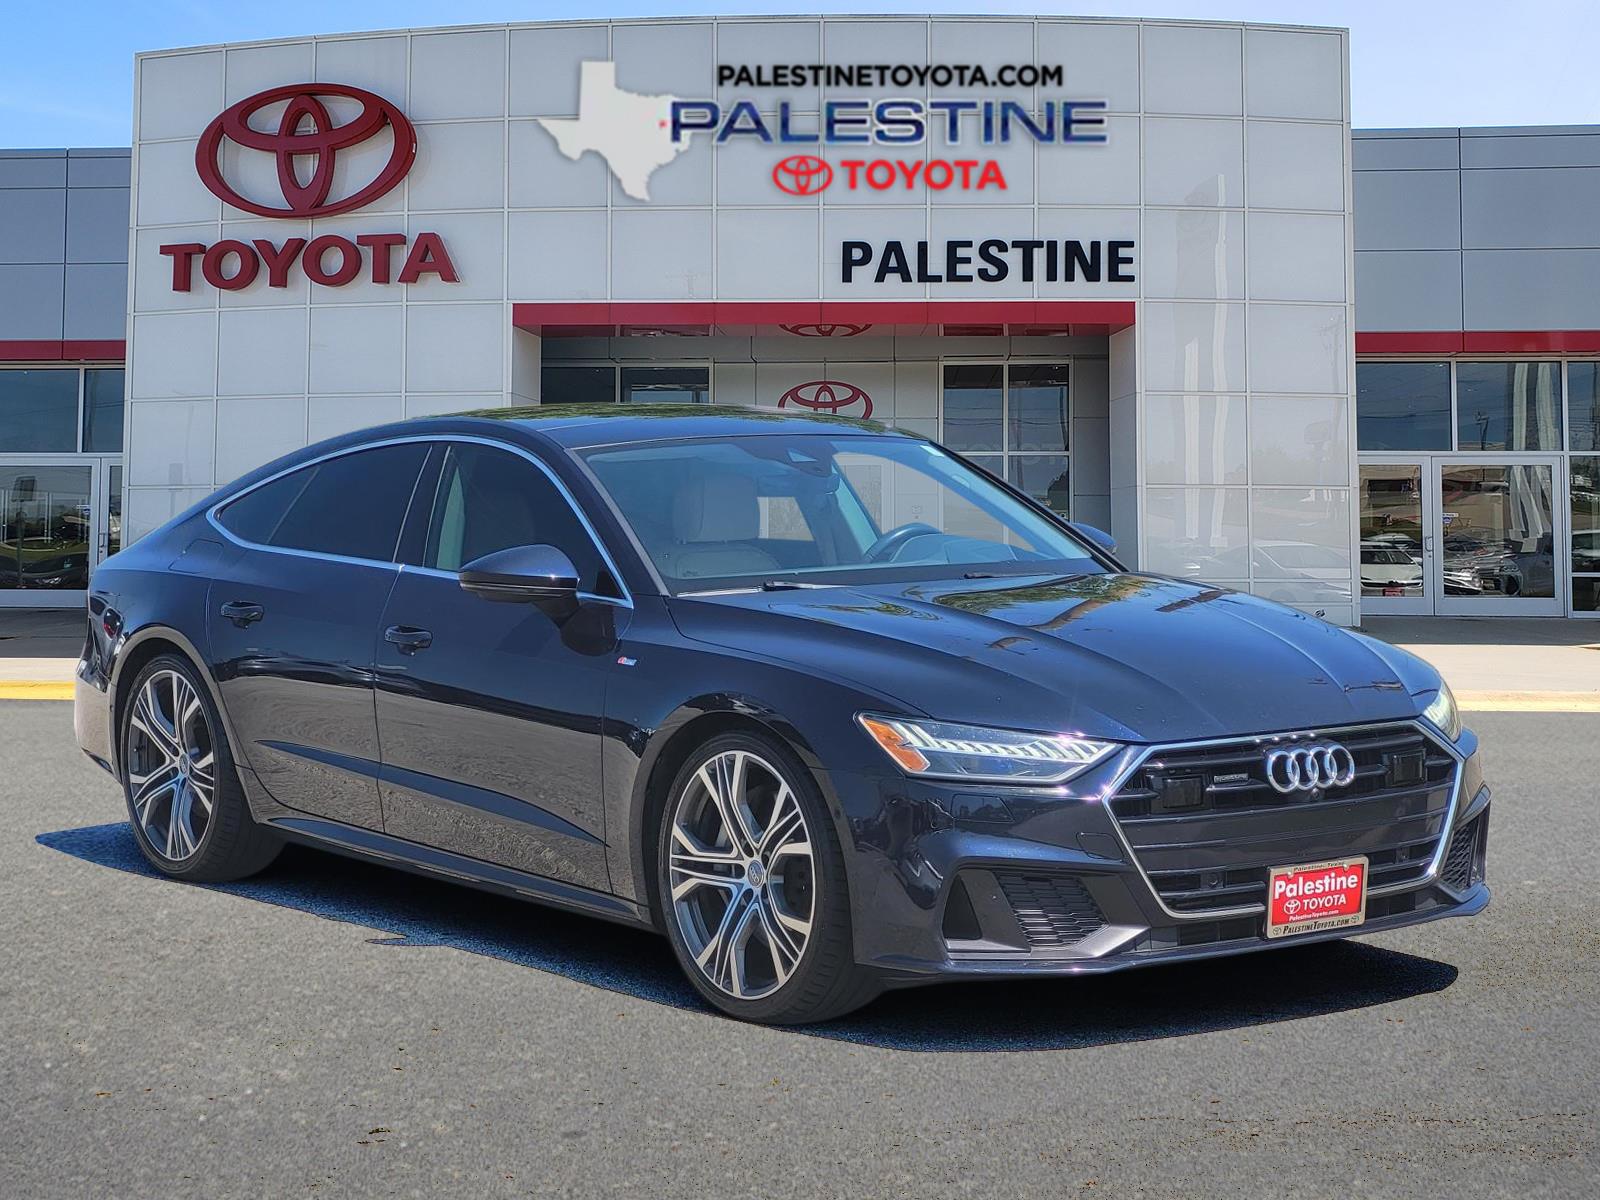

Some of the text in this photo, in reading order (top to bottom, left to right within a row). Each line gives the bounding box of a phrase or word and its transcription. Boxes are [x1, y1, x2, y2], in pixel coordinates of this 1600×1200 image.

[159, 232, 460, 292] TOYOTA
[842, 240, 1135, 283] PALESTINE
[1274, 872, 1358, 899] Palestine
[1303, 894, 1346, 910] TOYOTA
